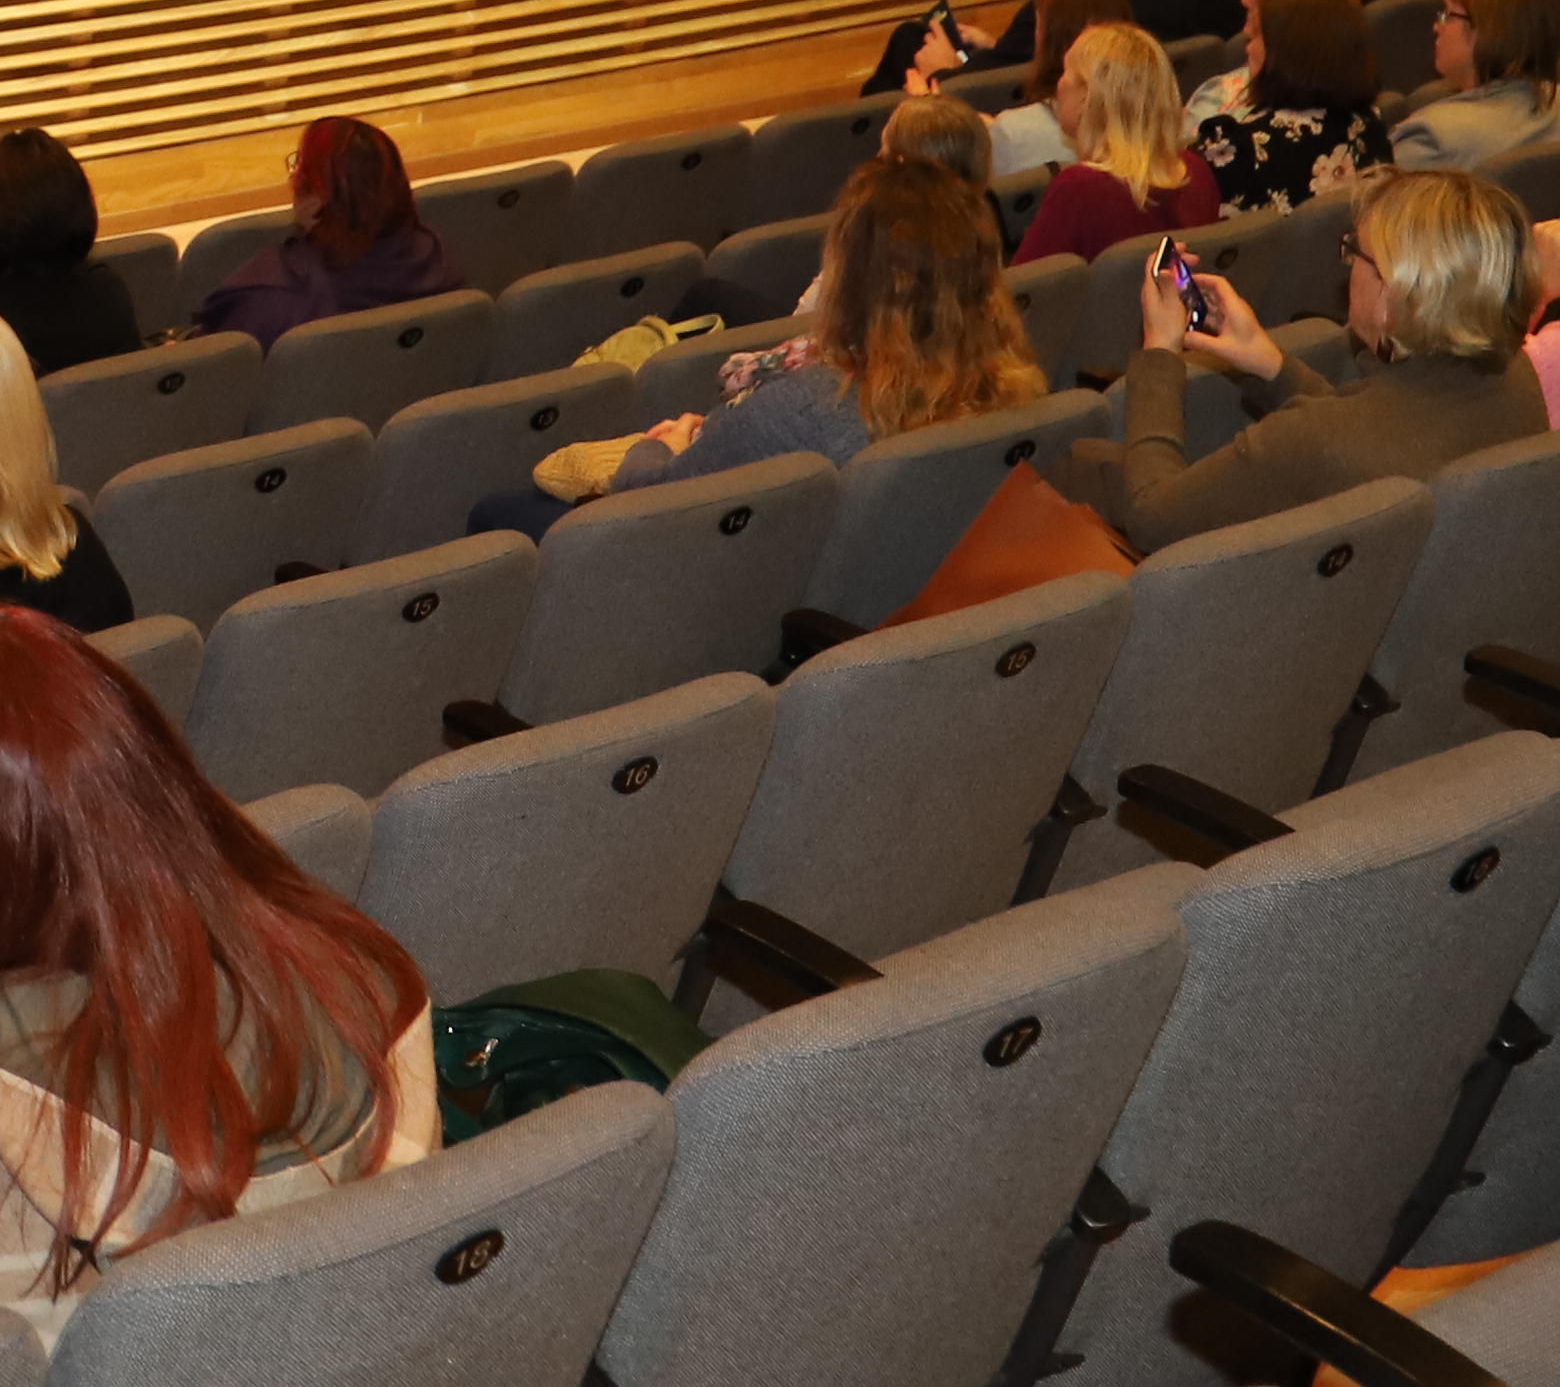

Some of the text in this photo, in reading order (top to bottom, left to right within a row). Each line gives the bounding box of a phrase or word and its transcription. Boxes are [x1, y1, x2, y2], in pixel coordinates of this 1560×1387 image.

[727, 512, 746, 530] 14
[412, 597, 433, 617] 15
[1007, 650, 1028, 672] 15
[624, 763, 651, 787] 16
[999, 1027, 1033, 1059] 17
